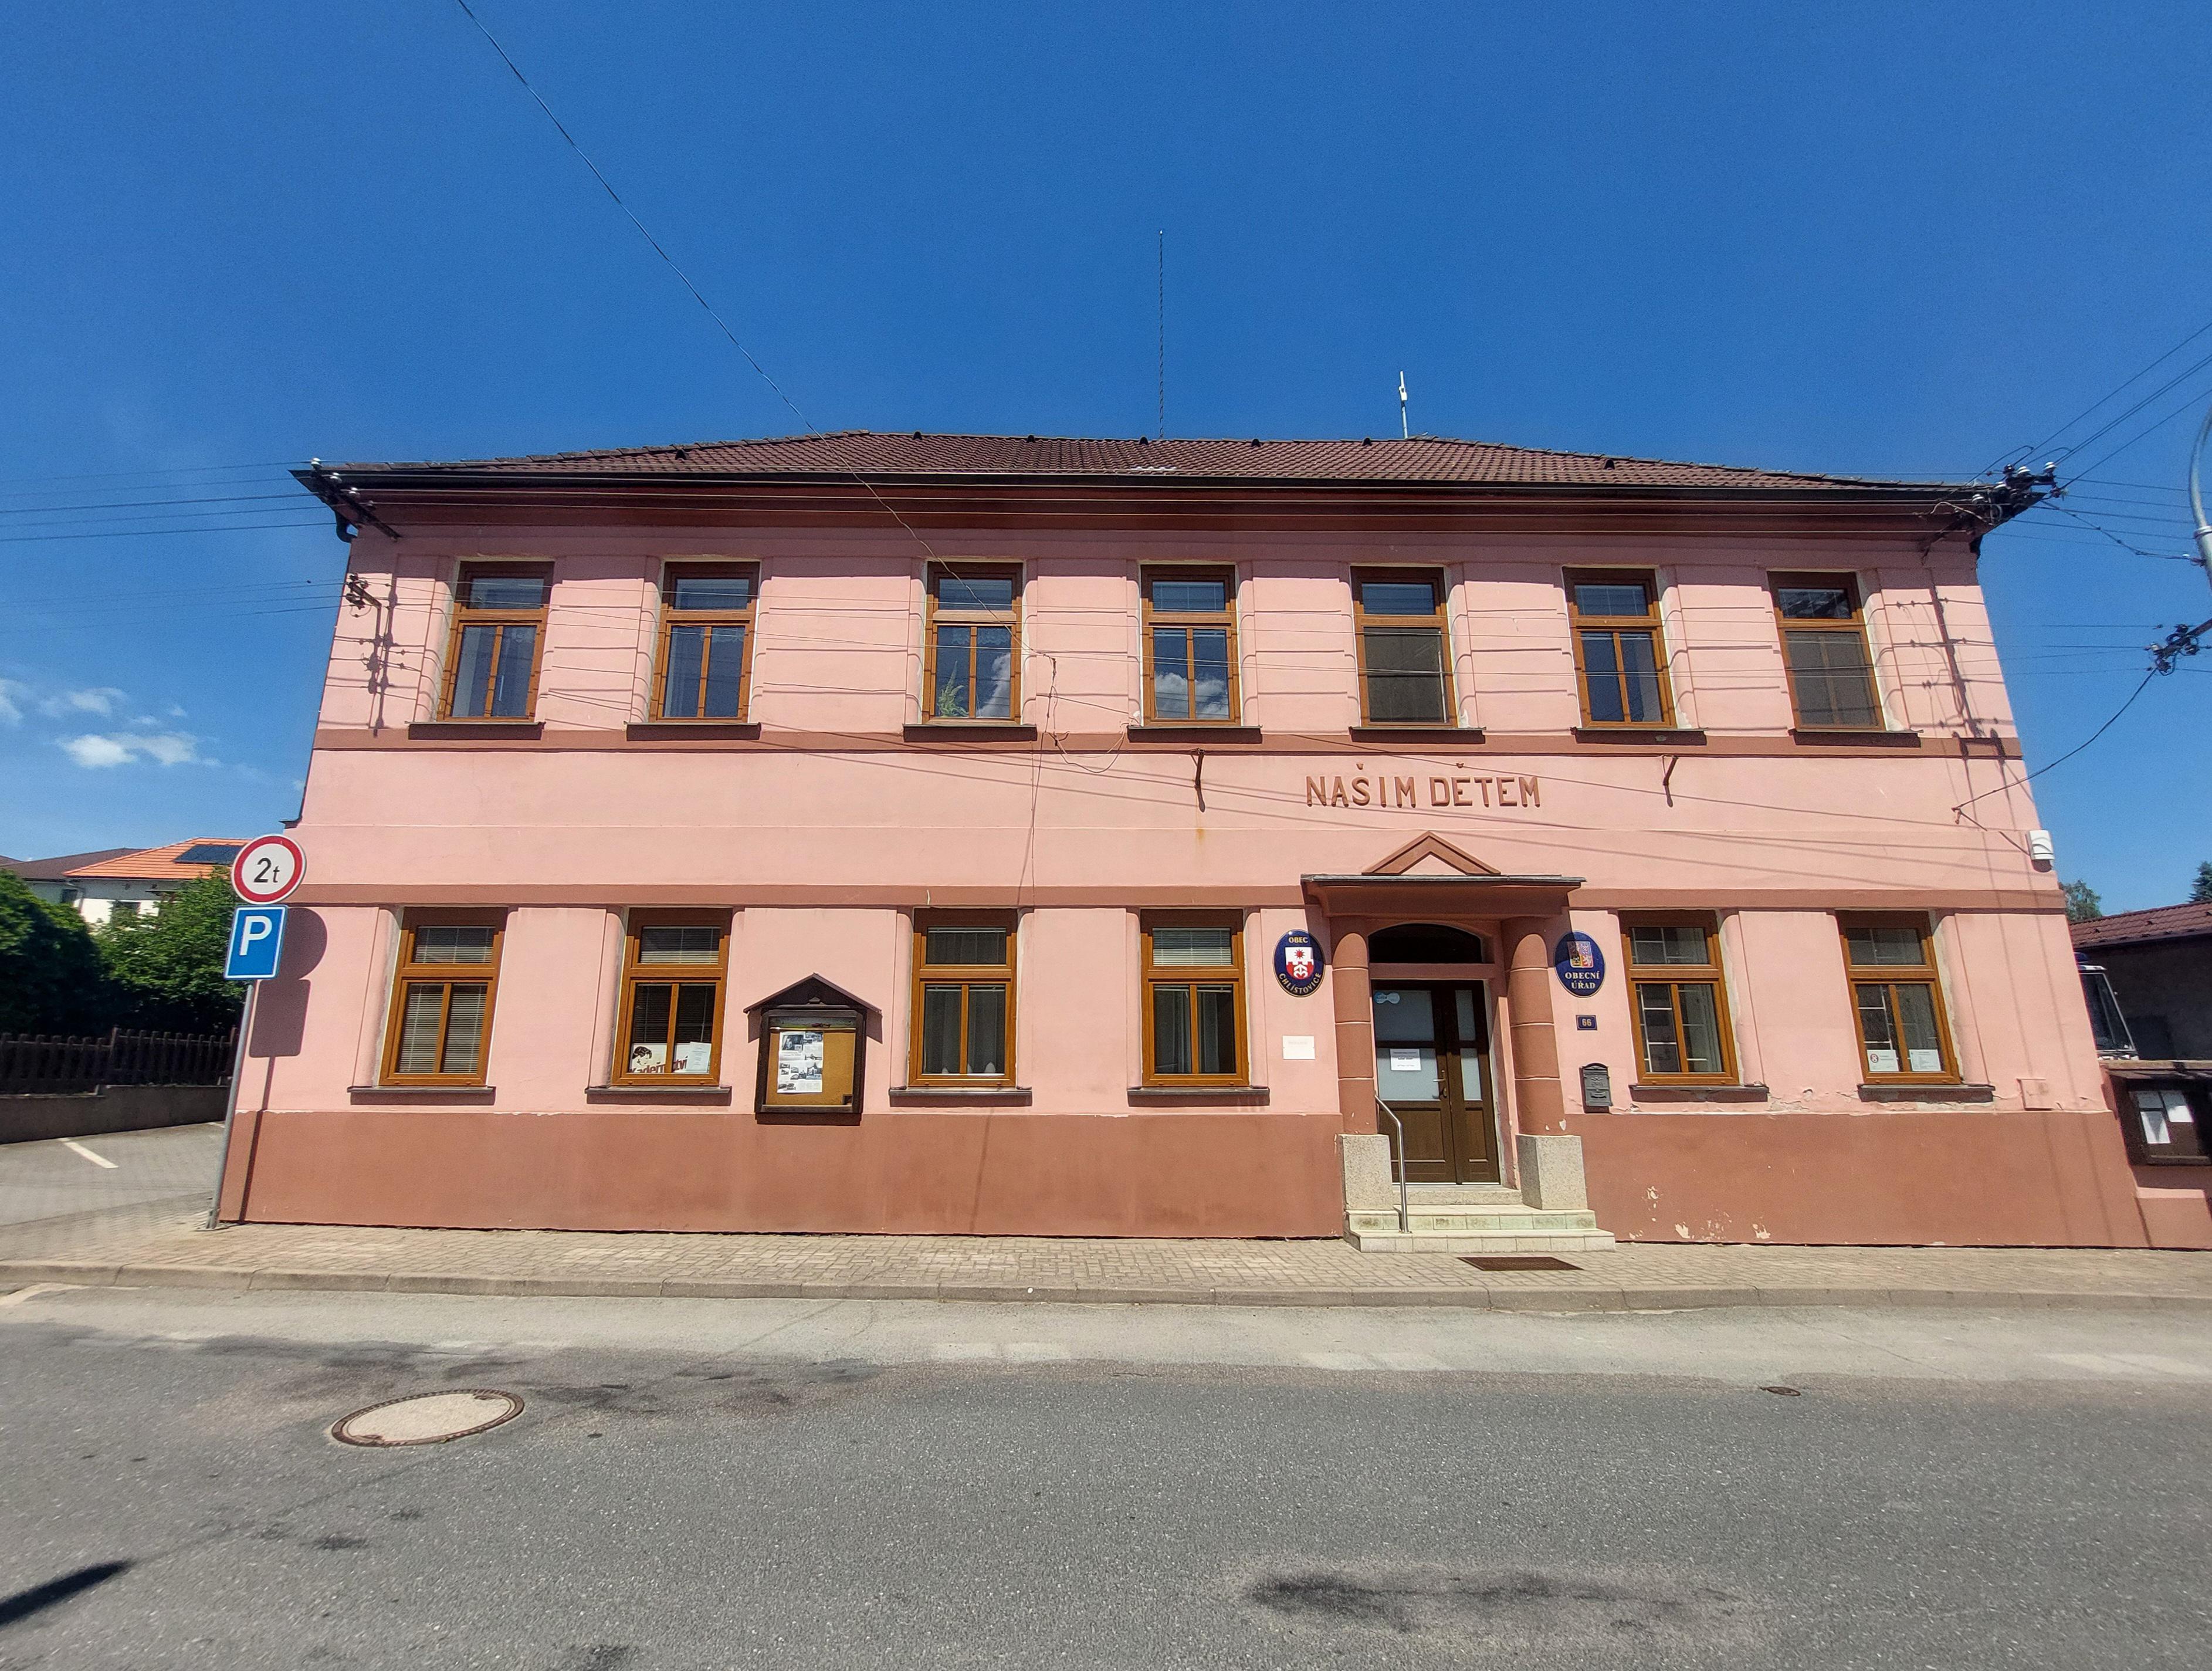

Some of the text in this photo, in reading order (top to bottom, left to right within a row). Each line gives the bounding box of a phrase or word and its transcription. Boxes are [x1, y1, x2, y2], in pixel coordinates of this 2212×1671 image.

[1306, 763, 1541, 808] NAŠIM DĚTEM
[239, 915, 273, 956] P
[1564, 971, 1600, 979] OBECNÍ
[1279, 973, 1321, 995] CHLÍSTOVICE
[1571, 980, 1596, 989] ÚŘAD
[1581, 1018, 1591, 1026] 66
